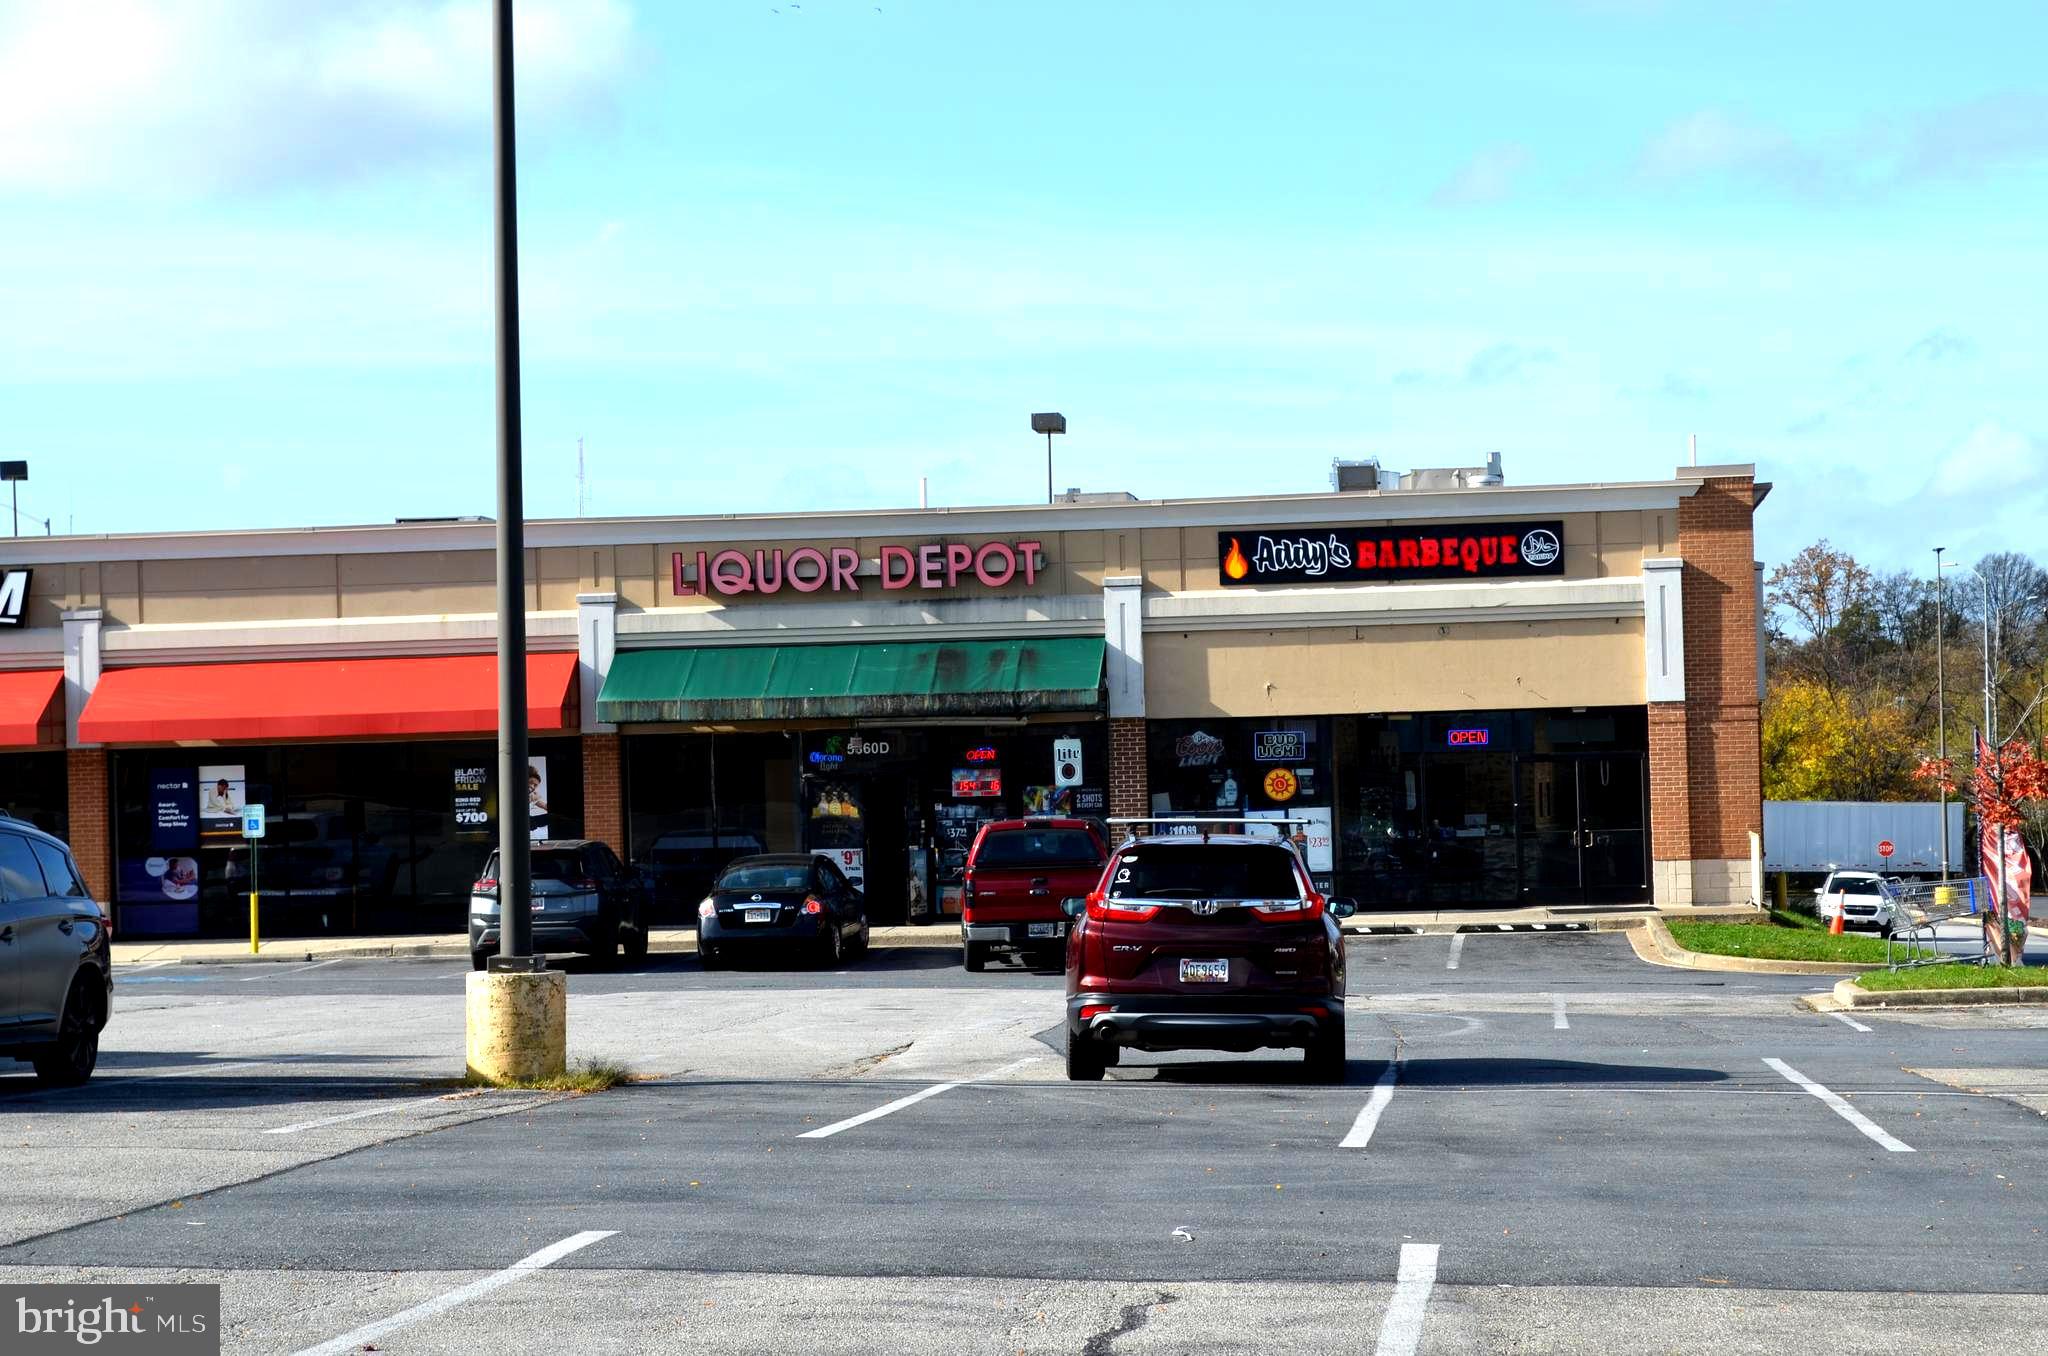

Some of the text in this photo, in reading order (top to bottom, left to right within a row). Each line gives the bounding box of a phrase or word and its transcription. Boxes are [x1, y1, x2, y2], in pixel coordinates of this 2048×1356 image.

[1252, 534, 1518, 574] Addy's BARBEQUE
[672, 541, 1041, 597] LIQUOR DEPOT
[1264, 733, 1297, 746] BUD
[1451, 731, 1486, 743] OPEN
[966, 750, 996, 761] OPEN
[1057, 748, 1080, 762] Lite
[1257, 745, 1304, 758] LIGHT
[810, 752, 844, 763] Corona
[455, 768, 486, 776] BLACK
[455, 776, 487, 784] FRIDAY
[1076, 793, 1103, 802] 2 SHOTS
[455, 812, 488, 823] $700
